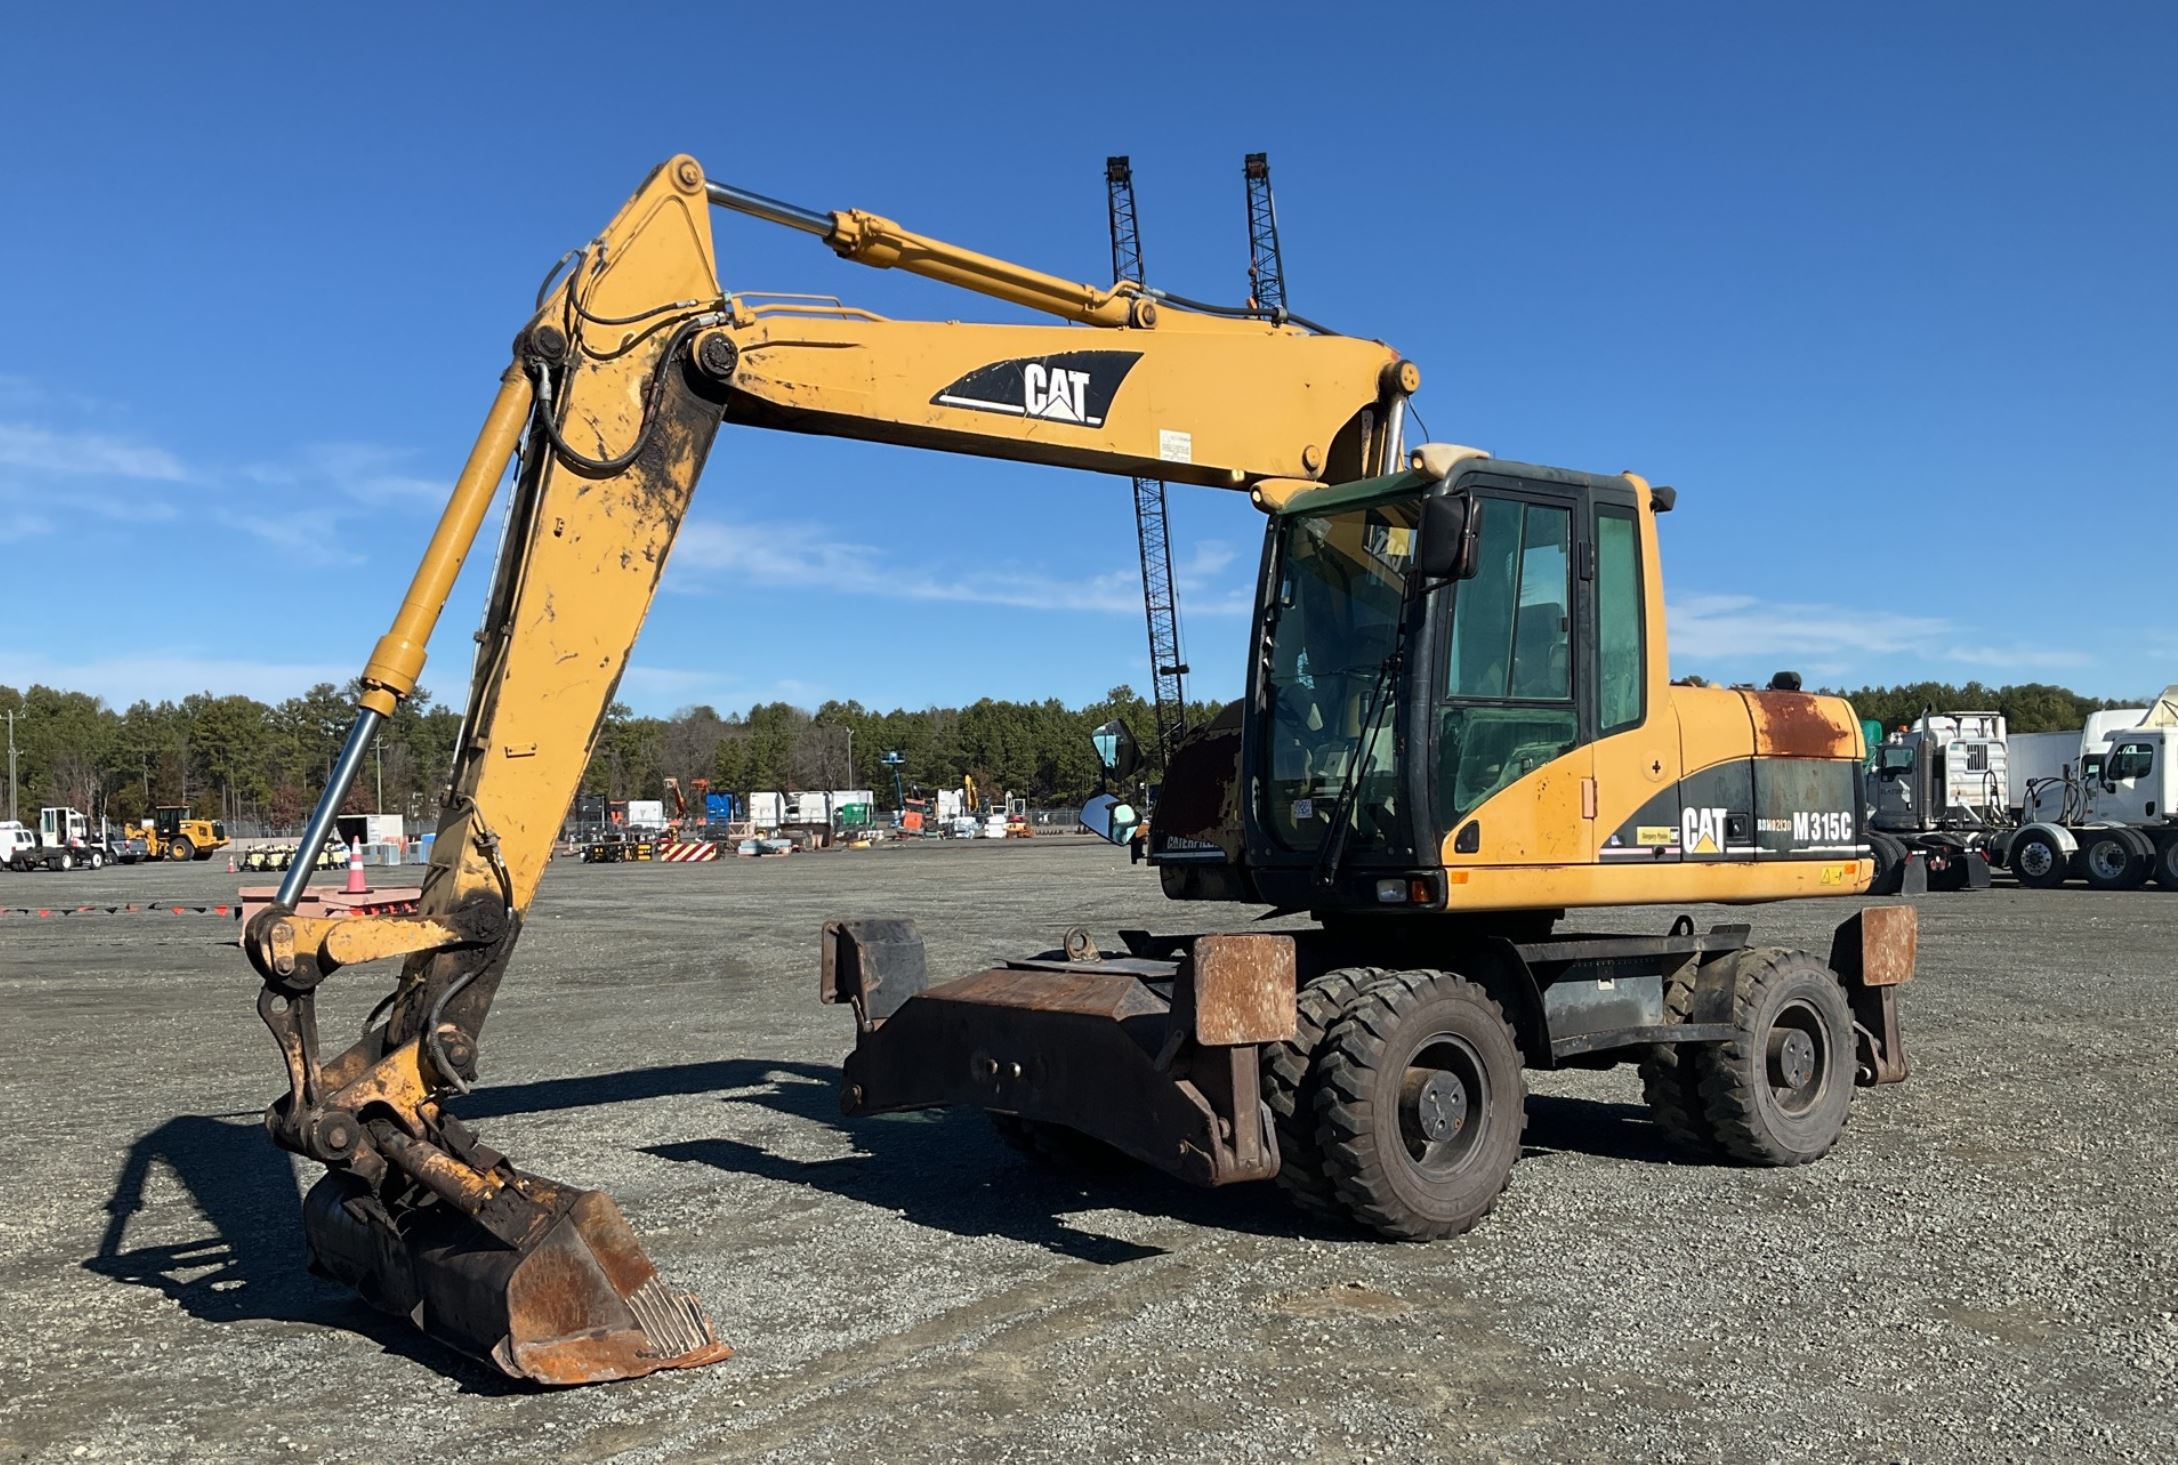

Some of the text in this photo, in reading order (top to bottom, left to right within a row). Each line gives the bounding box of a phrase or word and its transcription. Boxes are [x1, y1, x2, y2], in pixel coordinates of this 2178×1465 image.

[1024, 363, 1090, 422] CAT
[1682, 807, 1727, 853] CAT
[1793, 811, 1852, 841] M315C
